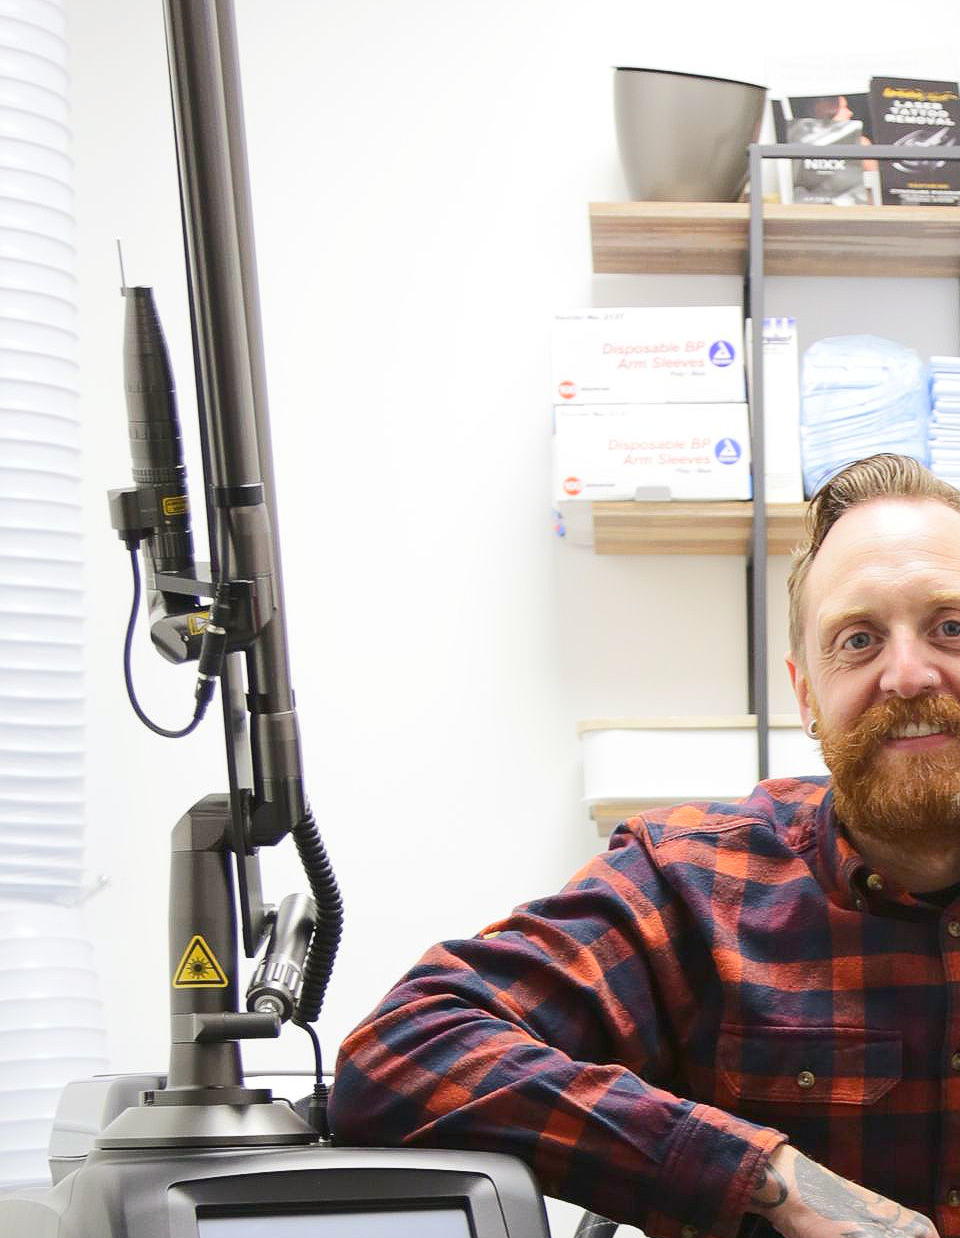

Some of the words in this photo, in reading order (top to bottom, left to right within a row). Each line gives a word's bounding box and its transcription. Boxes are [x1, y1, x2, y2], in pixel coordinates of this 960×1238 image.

[889, 106, 949, 118] TATTOO
[884, 113, 956, 126] REMOVAL
[602, 341, 680, 355] Disposable
[684, 340, 705, 352] BP
[617, 358, 647, 370] Arm
[652, 357, 705, 369] Sleeves
[608, 438, 686, 452] Disposable
[690, 437, 711, 450] BP
[623, 454, 652, 466] Arm
[658, 453, 711, 465] Sleeves
